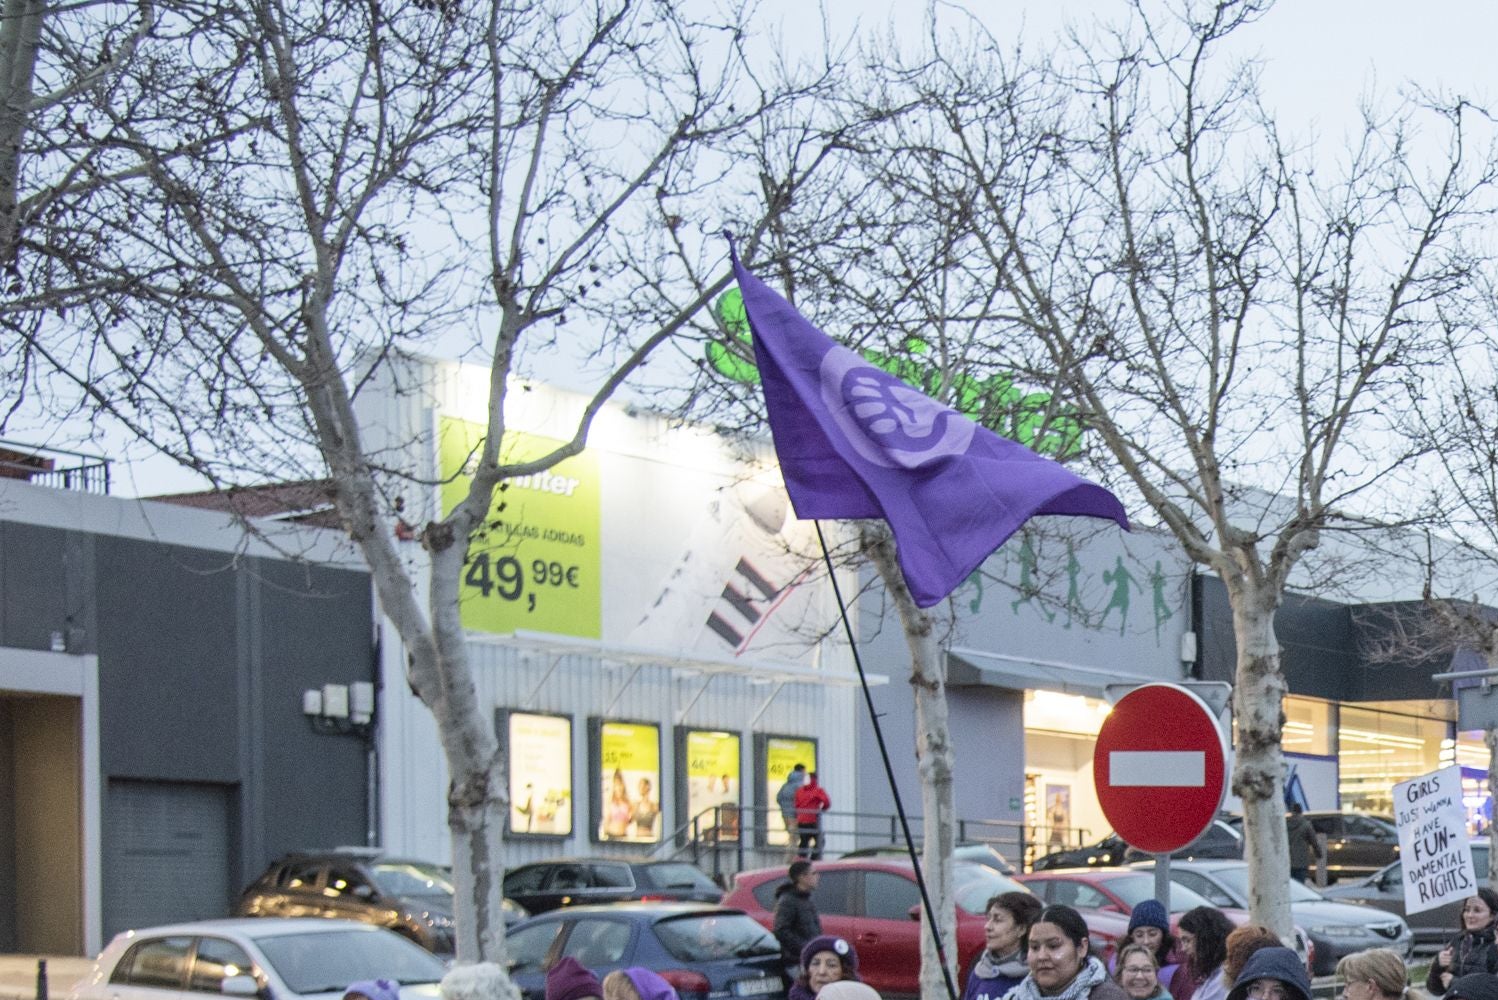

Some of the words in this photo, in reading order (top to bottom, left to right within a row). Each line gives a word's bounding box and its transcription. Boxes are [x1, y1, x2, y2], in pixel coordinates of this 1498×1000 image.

[1407, 776, 1441, 803] GIRLS
[1423, 798, 1453, 814] WANNA
[1414, 817, 1441, 839] HAVE
[1414, 827, 1456, 862] FUN-
[1409, 850, 1466, 883] DAMENTAL
[1418, 866, 1473, 903] RIGHTS.
